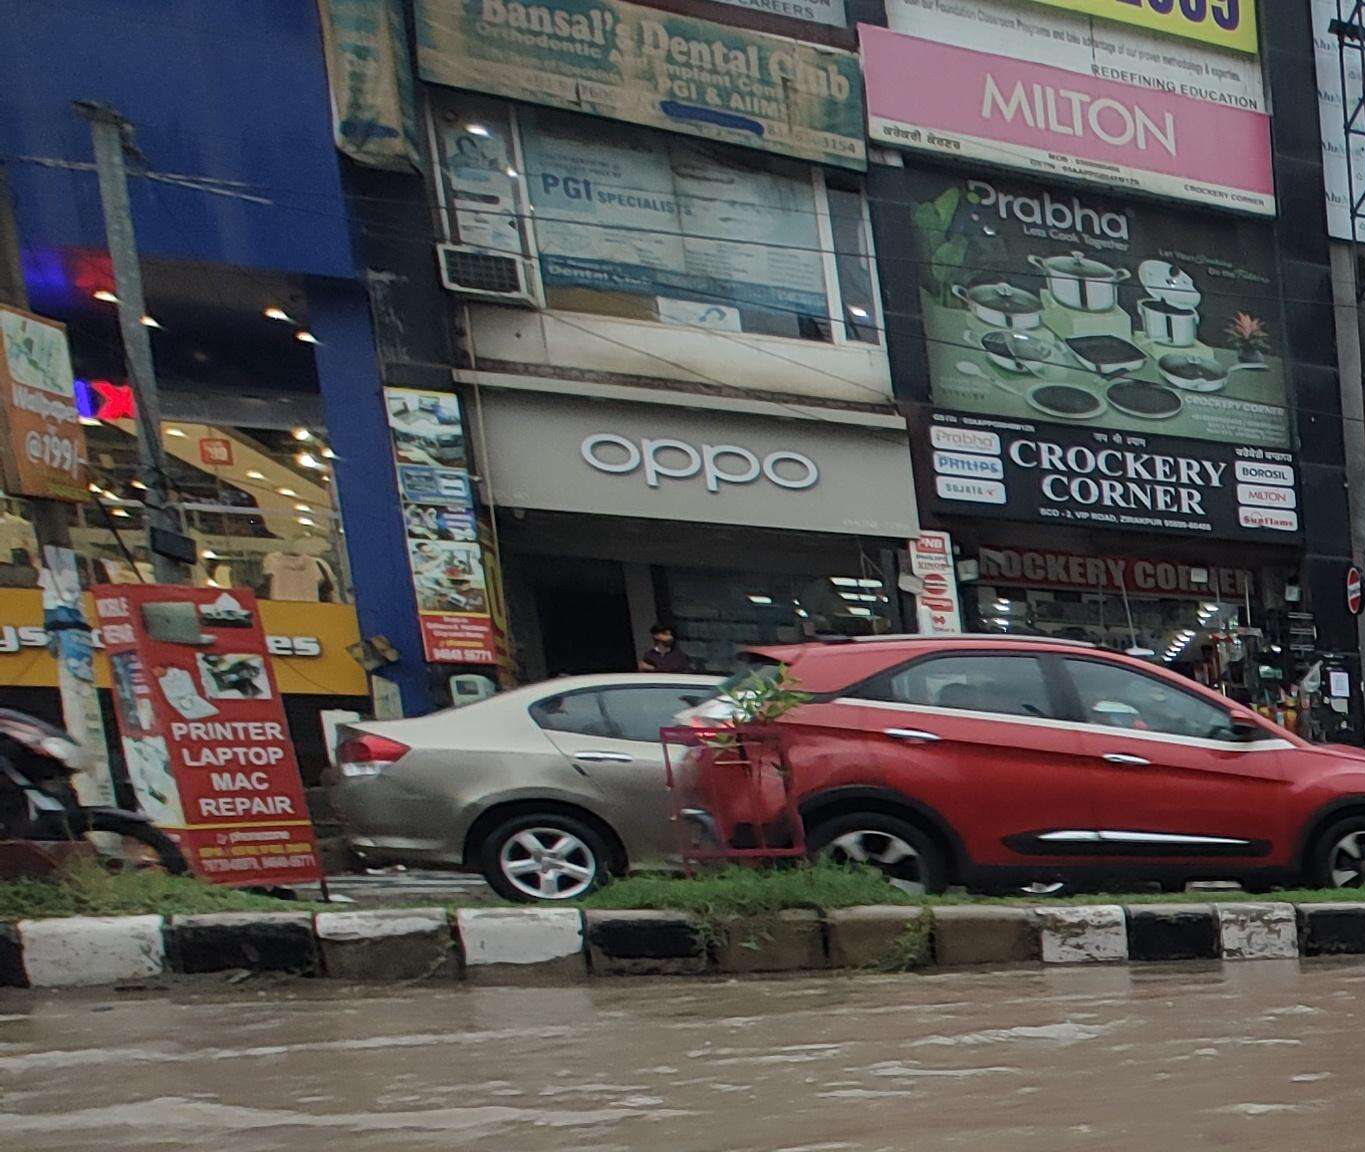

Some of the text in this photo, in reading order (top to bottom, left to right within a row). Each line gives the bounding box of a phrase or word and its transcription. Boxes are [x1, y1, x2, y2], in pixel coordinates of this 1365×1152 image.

[642, 20, 760, 79] Dental
[1091, 63, 1258, 110] REDEFINING EDUCATION
[981, 72, 1177, 160] MILTON
[541, 172, 695, 217] PGI SPECIALISTS
[1049, 228, 1081, 244] Cook
[1082, 233, 1130, 251] Together
[580, 432, 818, 493] oppo
[938, 455, 1000, 474] PHILIPS
[1009, 438, 1228, 488] CROCKERY
[1242, 466, 1288, 482] BOROSIL
[944, 482, 984, 496] SUJATA
[1041, 474, 1206, 516] CORNER
[1247, 490, 1287, 503] MILTON
[1075, 510, 1090, 520] VIP
[1091, 513, 1119, 523] ROAD,
[171, 722, 285, 742] PRINTER
[181, 747, 285, 767] LAPTOP
[209, 772, 270, 792] MAC
[199, 796, 295, 817] REPAIR
